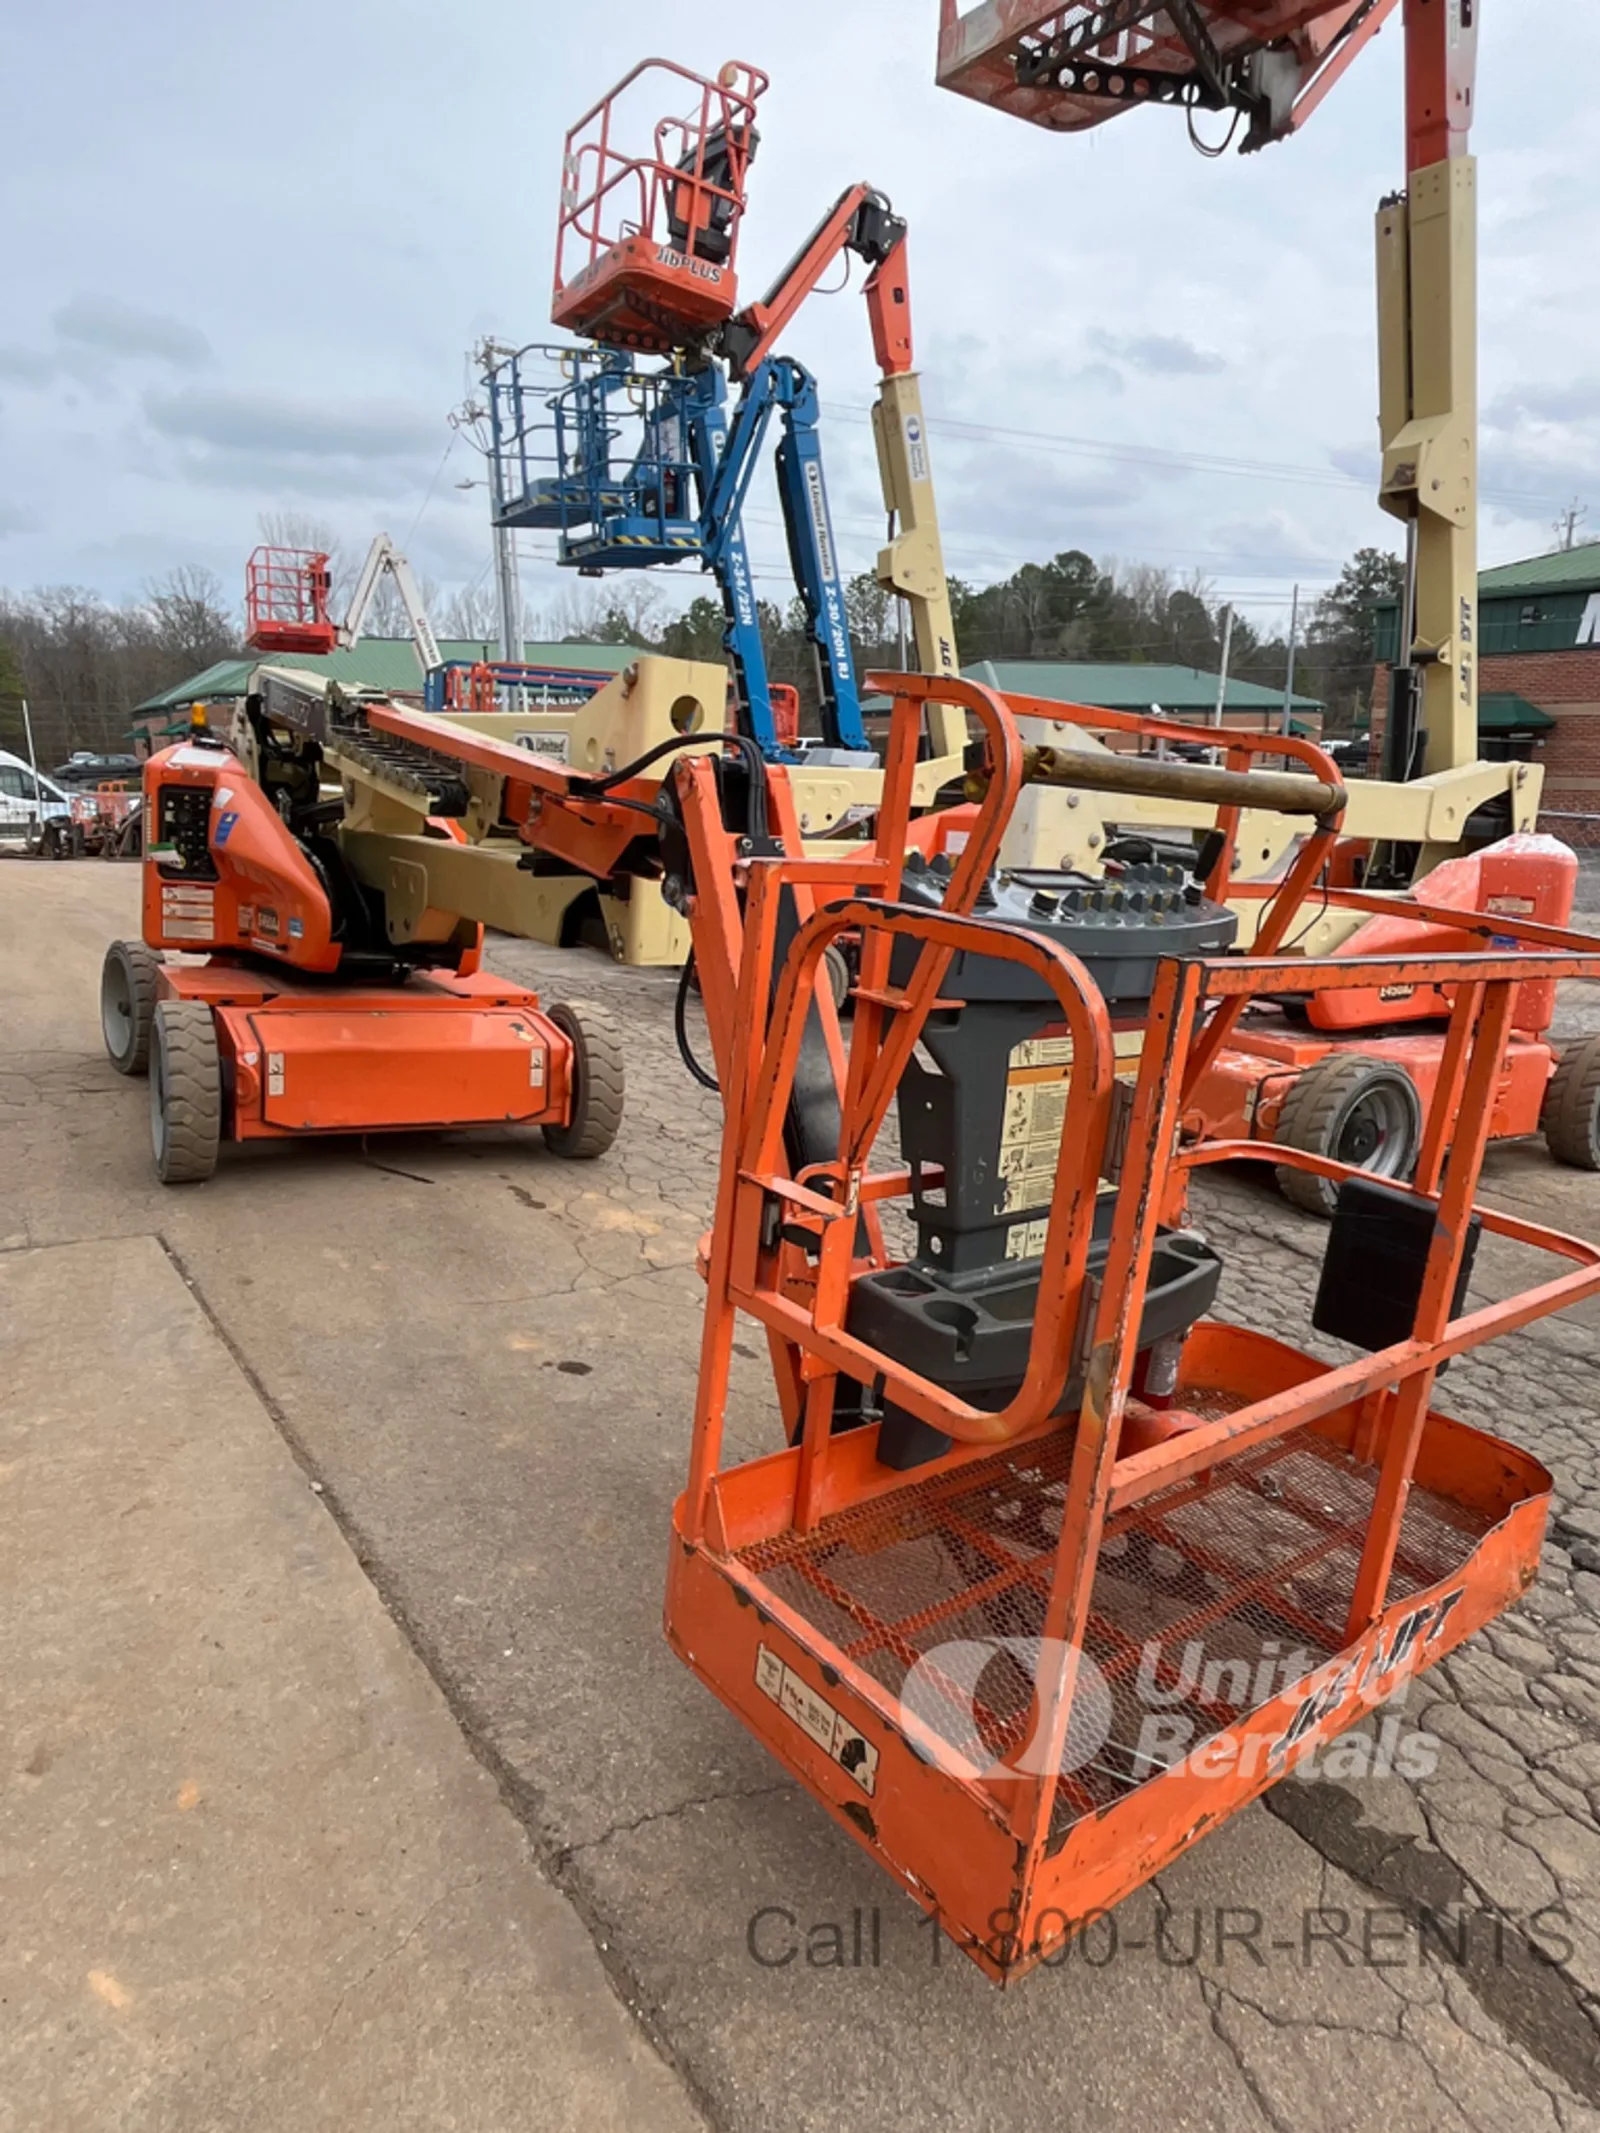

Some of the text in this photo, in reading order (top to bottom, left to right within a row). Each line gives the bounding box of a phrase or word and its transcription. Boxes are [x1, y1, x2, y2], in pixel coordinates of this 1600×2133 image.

[656, 247, 722, 284] JibPLUS
[810, 484, 823, 527] United
[730, 552, 753, 626] Z-34/22N
[825, 586, 847, 658] Z-30/20N
[938, 636, 952, 667] JLG
[536, 736, 565, 753] United
